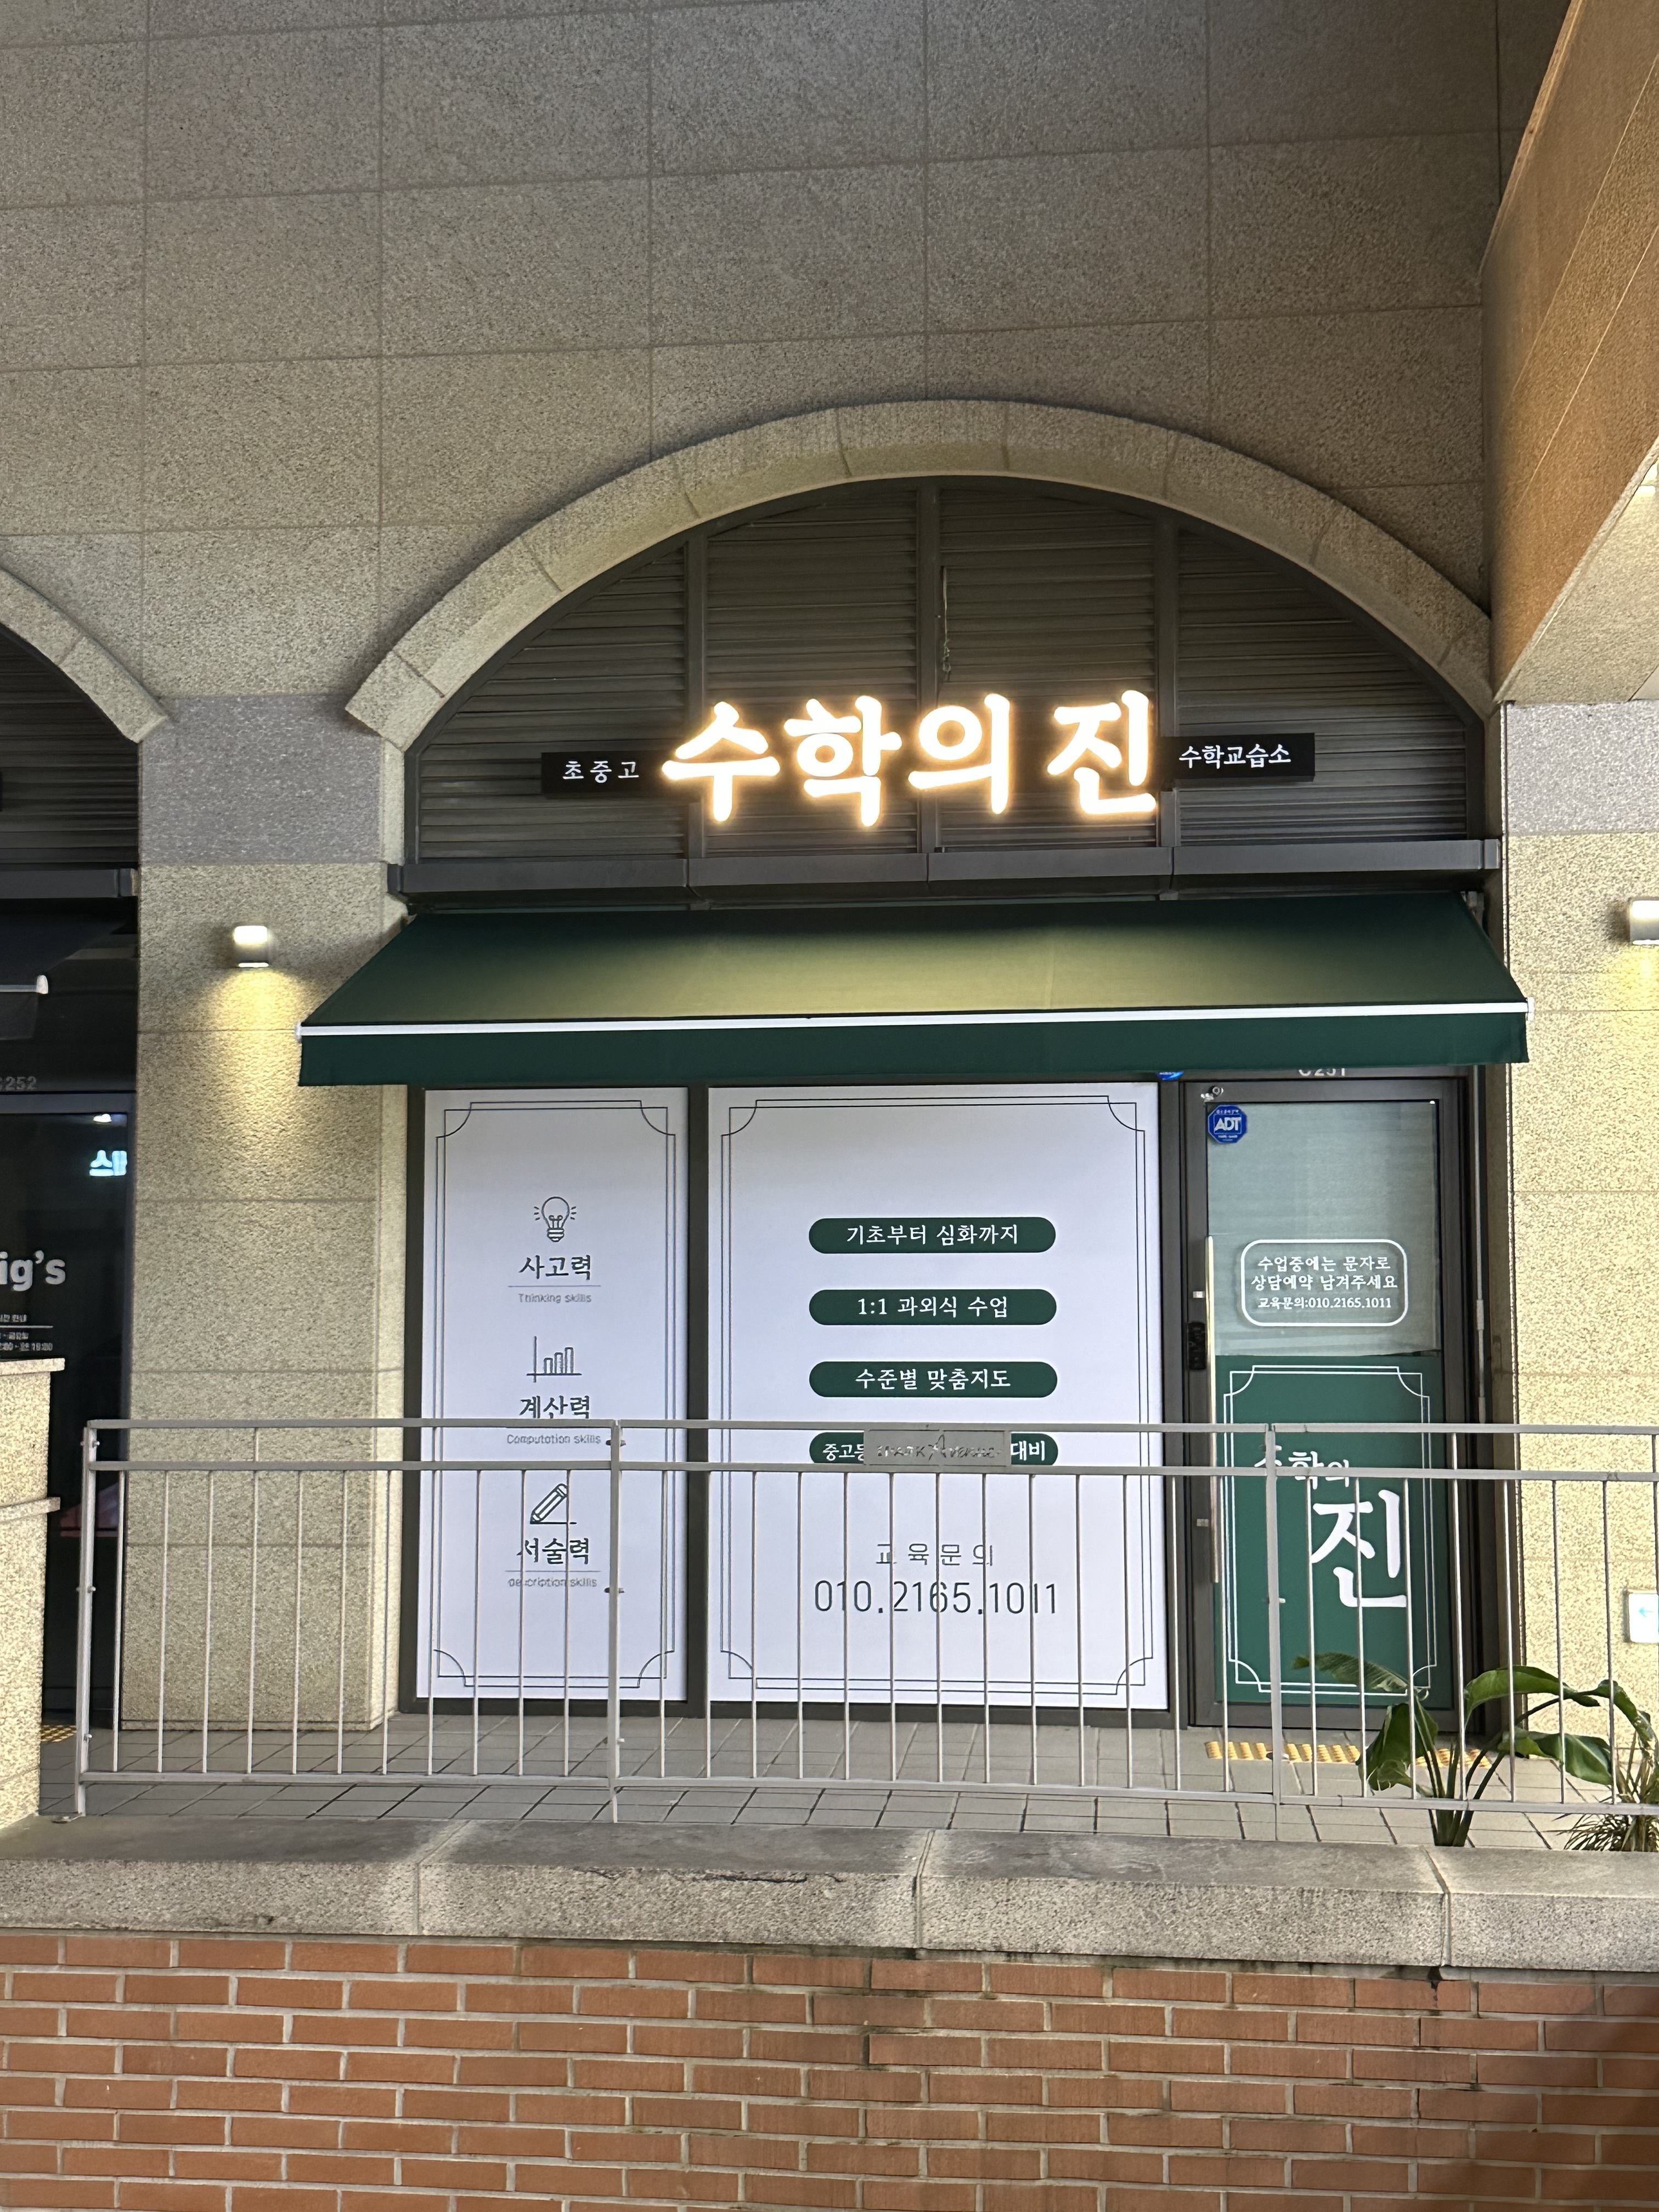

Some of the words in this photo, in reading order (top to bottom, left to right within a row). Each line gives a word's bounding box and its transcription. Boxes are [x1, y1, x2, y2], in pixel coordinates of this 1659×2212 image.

[662, 693, 1011, 827] 수학의
[1046, 690, 1157, 816] 진
[1179, 743, 1291, 769] 수학교습소
[0, 1076, 37, 1090] 252
[1214, 1116, 1242, 1131] ADT
[847, 1224, 926, 1245] 기초부터
[936, 1224, 1018, 1246] 심화까지
[518, 1254, 591, 1280] 사고력
[1257, 1256, 1336, 1272] 수업중에는
[1343, 1255, 1391, 1272] 문자로
[1251, 1274, 1313, 1291] 상담예약
[1320, 1274, 1398, 1291] 남겨주세요
[857, 1298, 887, 1315] 1:1
[898, 1296, 957, 1318] 과외식
[967, 1296, 1007, 1318] 수업
[855, 1368, 918, 1390] 수준별
[927, 1368, 1011, 1391] 맞춤지도
[519, 1395, 590, 1419] 계산력
[1010, 1440, 1045, 1462] 대비
[516, 1537, 590, 1565] 서술력
[1311, 1489, 1407, 1607] 진
[815, 1580, 1056, 1614] 010.2165.1011
